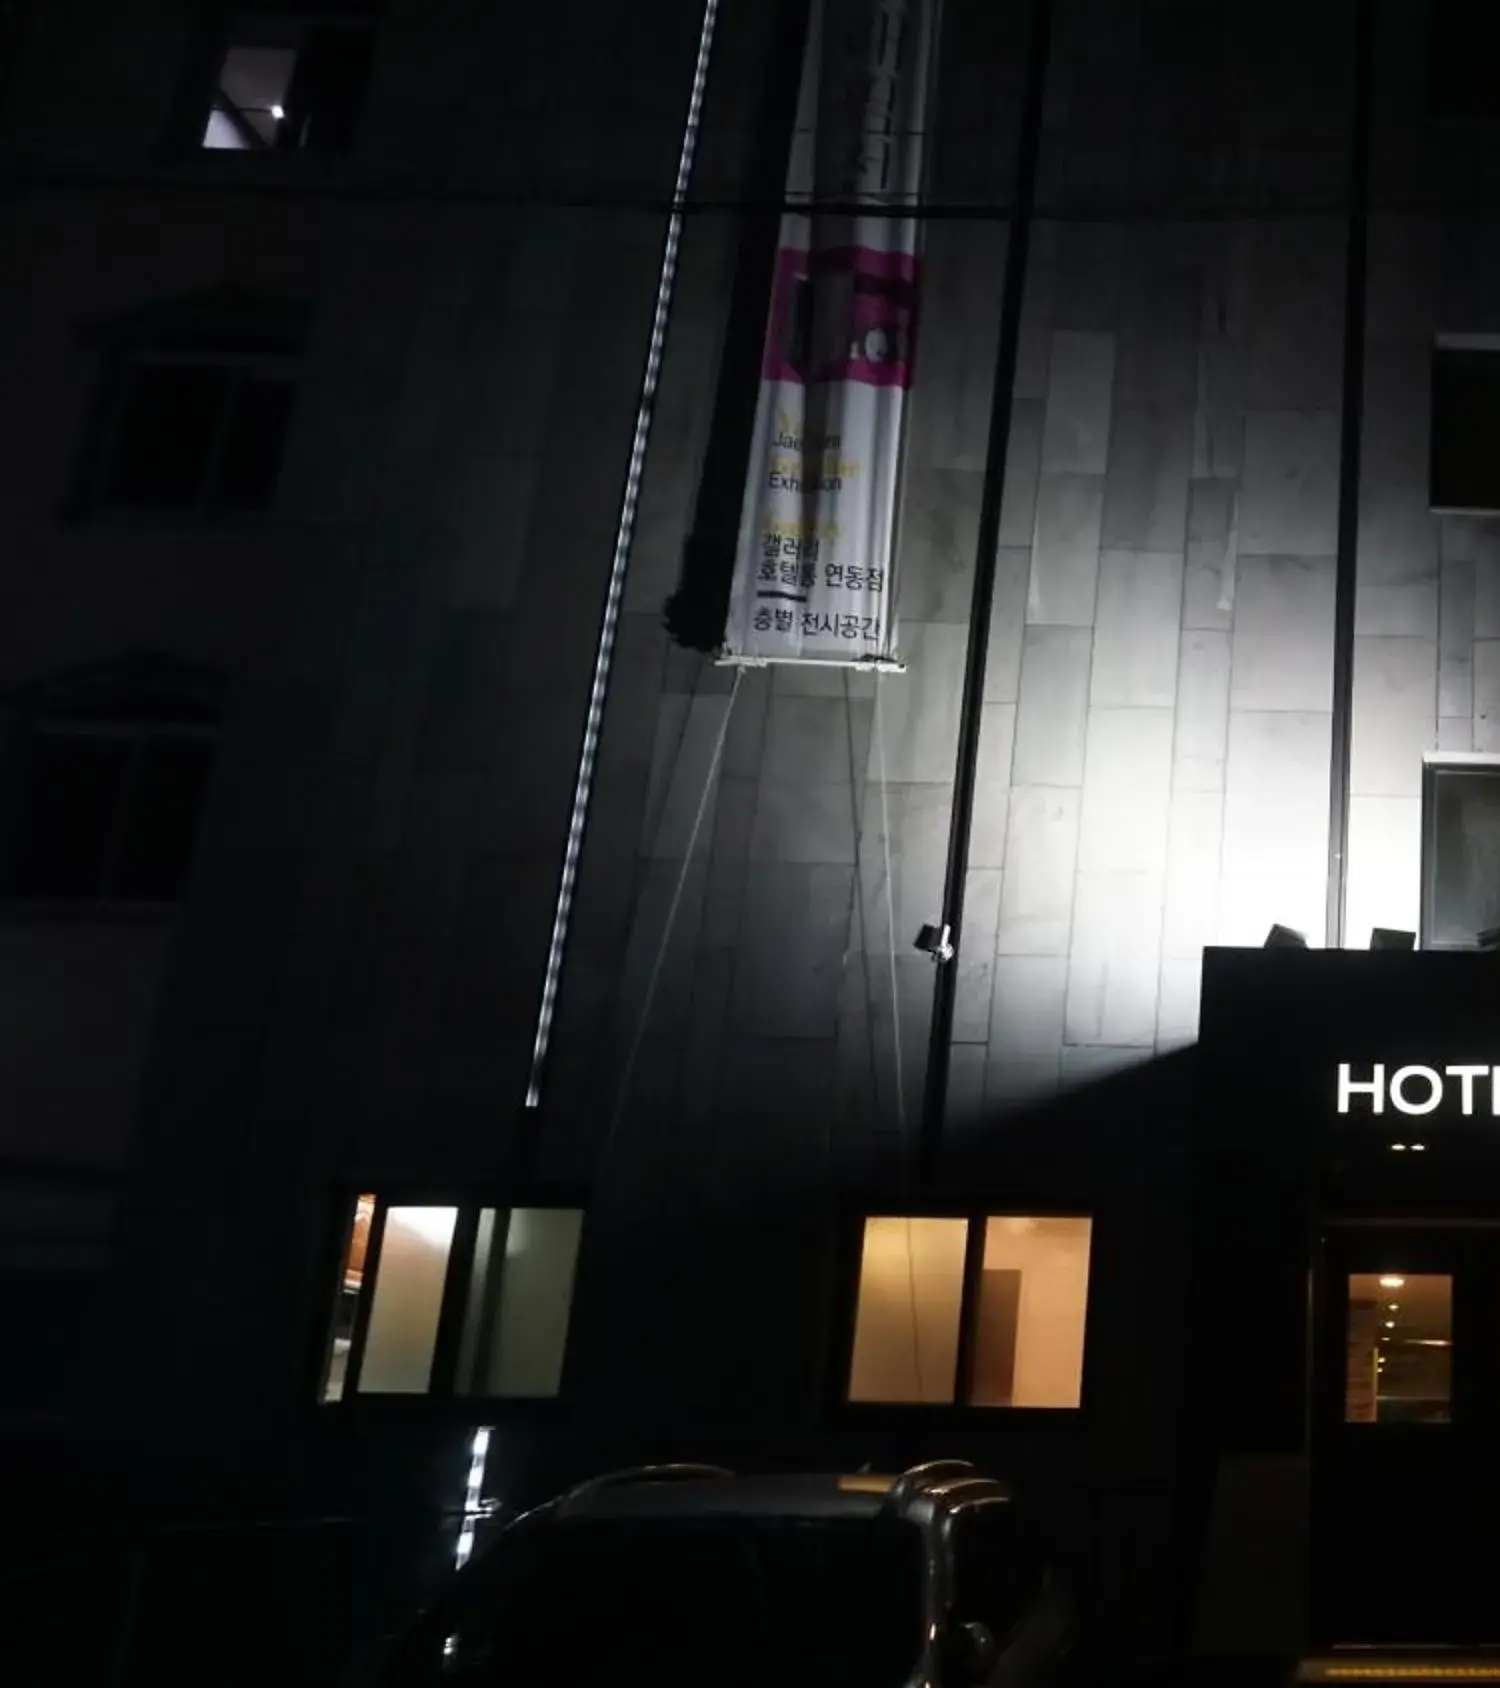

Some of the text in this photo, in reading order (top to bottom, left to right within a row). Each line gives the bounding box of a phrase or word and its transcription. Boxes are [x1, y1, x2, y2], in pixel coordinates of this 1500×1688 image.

[824, 562, 884, 593] 연동점
[753, 605, 881, 641] 층별 전시공간
